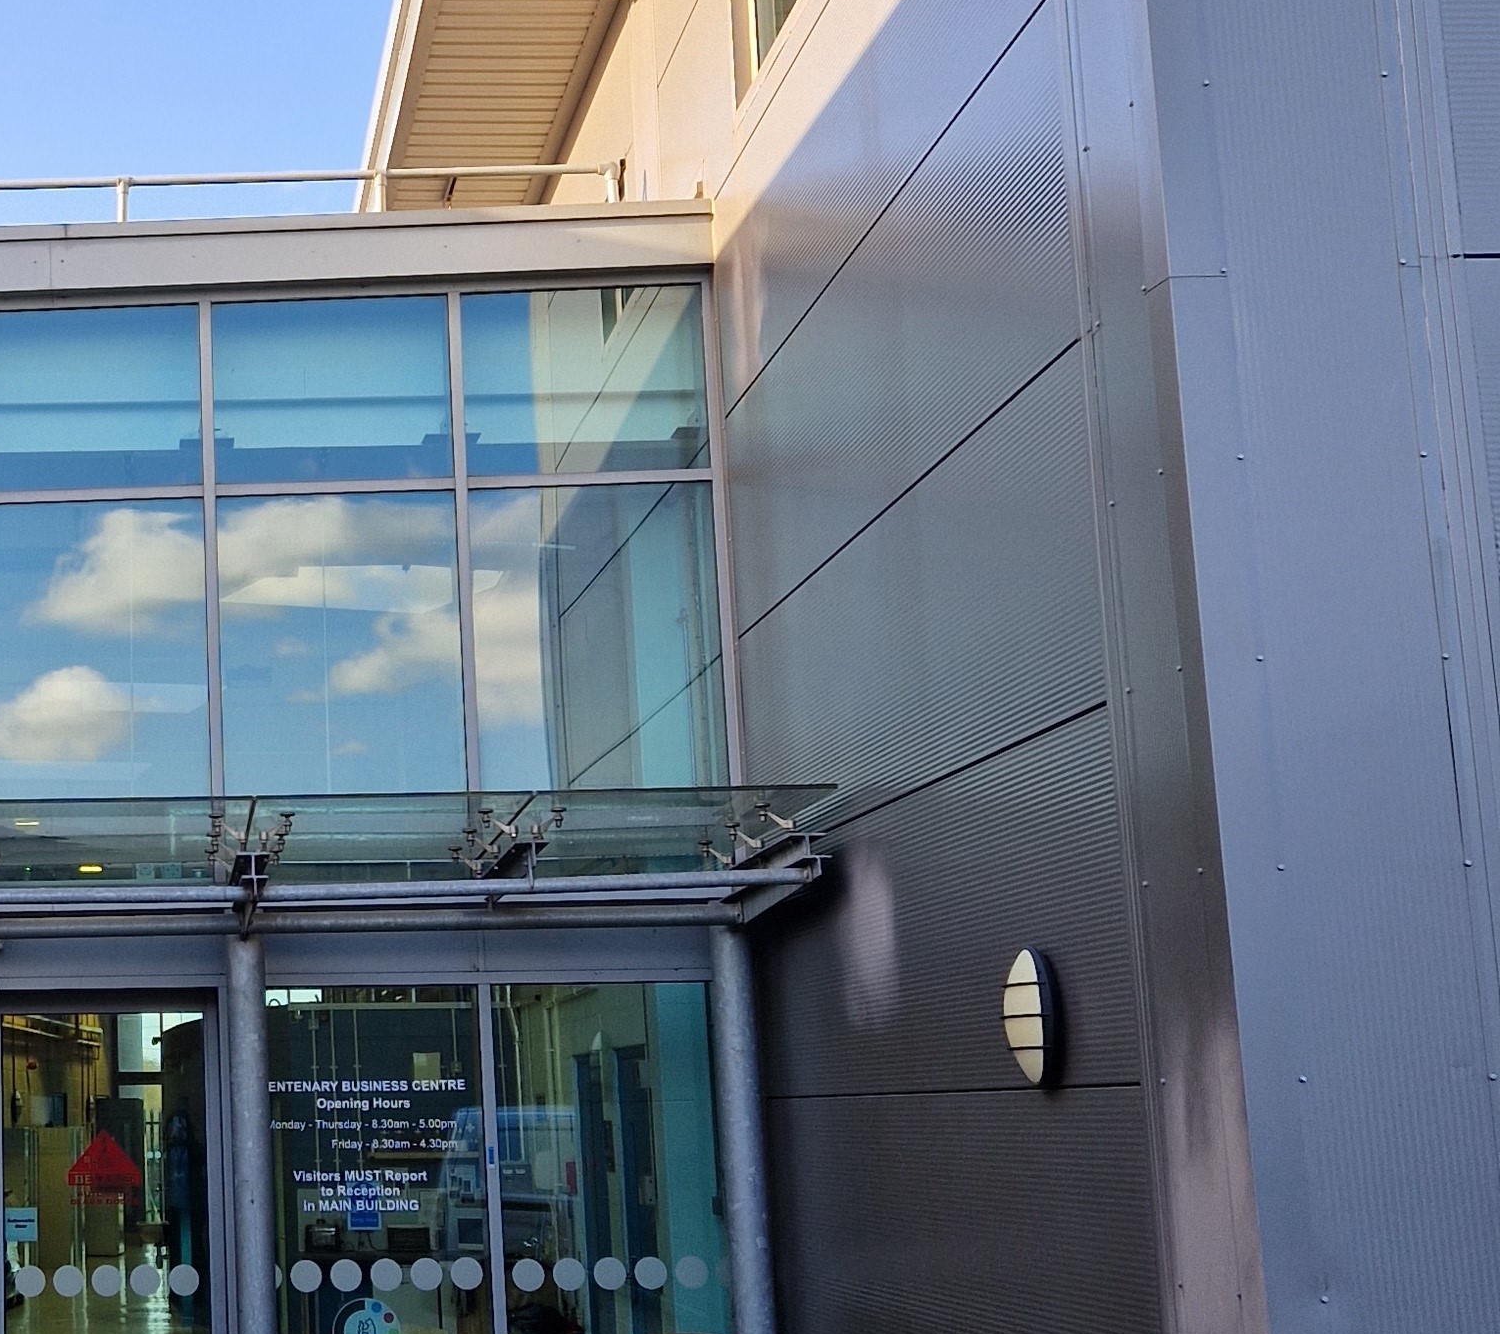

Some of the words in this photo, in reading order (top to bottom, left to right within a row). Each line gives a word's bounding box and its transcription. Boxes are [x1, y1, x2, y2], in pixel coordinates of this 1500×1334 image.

[268, 1081, 338, 1092] ENTENARY
[342, 1080, 409, 1092] BUSINESS
[412, 1079, 466, 1091] CENTRE
[317, 1097, 370, 1111] Opening
[373, 1097, 411, 1109] Hours
[315, 1119, 363, 1131] Thursday
[371, 1119, 410, 1129] 8.30am
[419, 1119, 457, 1131] 5.00pm
[331, 1139, 363, 1151] Friday
[371, 1139, 410, 1149] 8.30am
[419, 1139, 458, 1151] 4.30pm
[293, 1170, 340, 1182] Visitors
[344, 1170, 382, 1181] MUST
[384, 1169, 427, 1183] Report
[320, 1185, 333, 1197] to
[337, 1185, 400, 1198] Reception
[319, 1200, 351, 1211] MAIN
[356, 1199, 420, 1211] BUILDING
